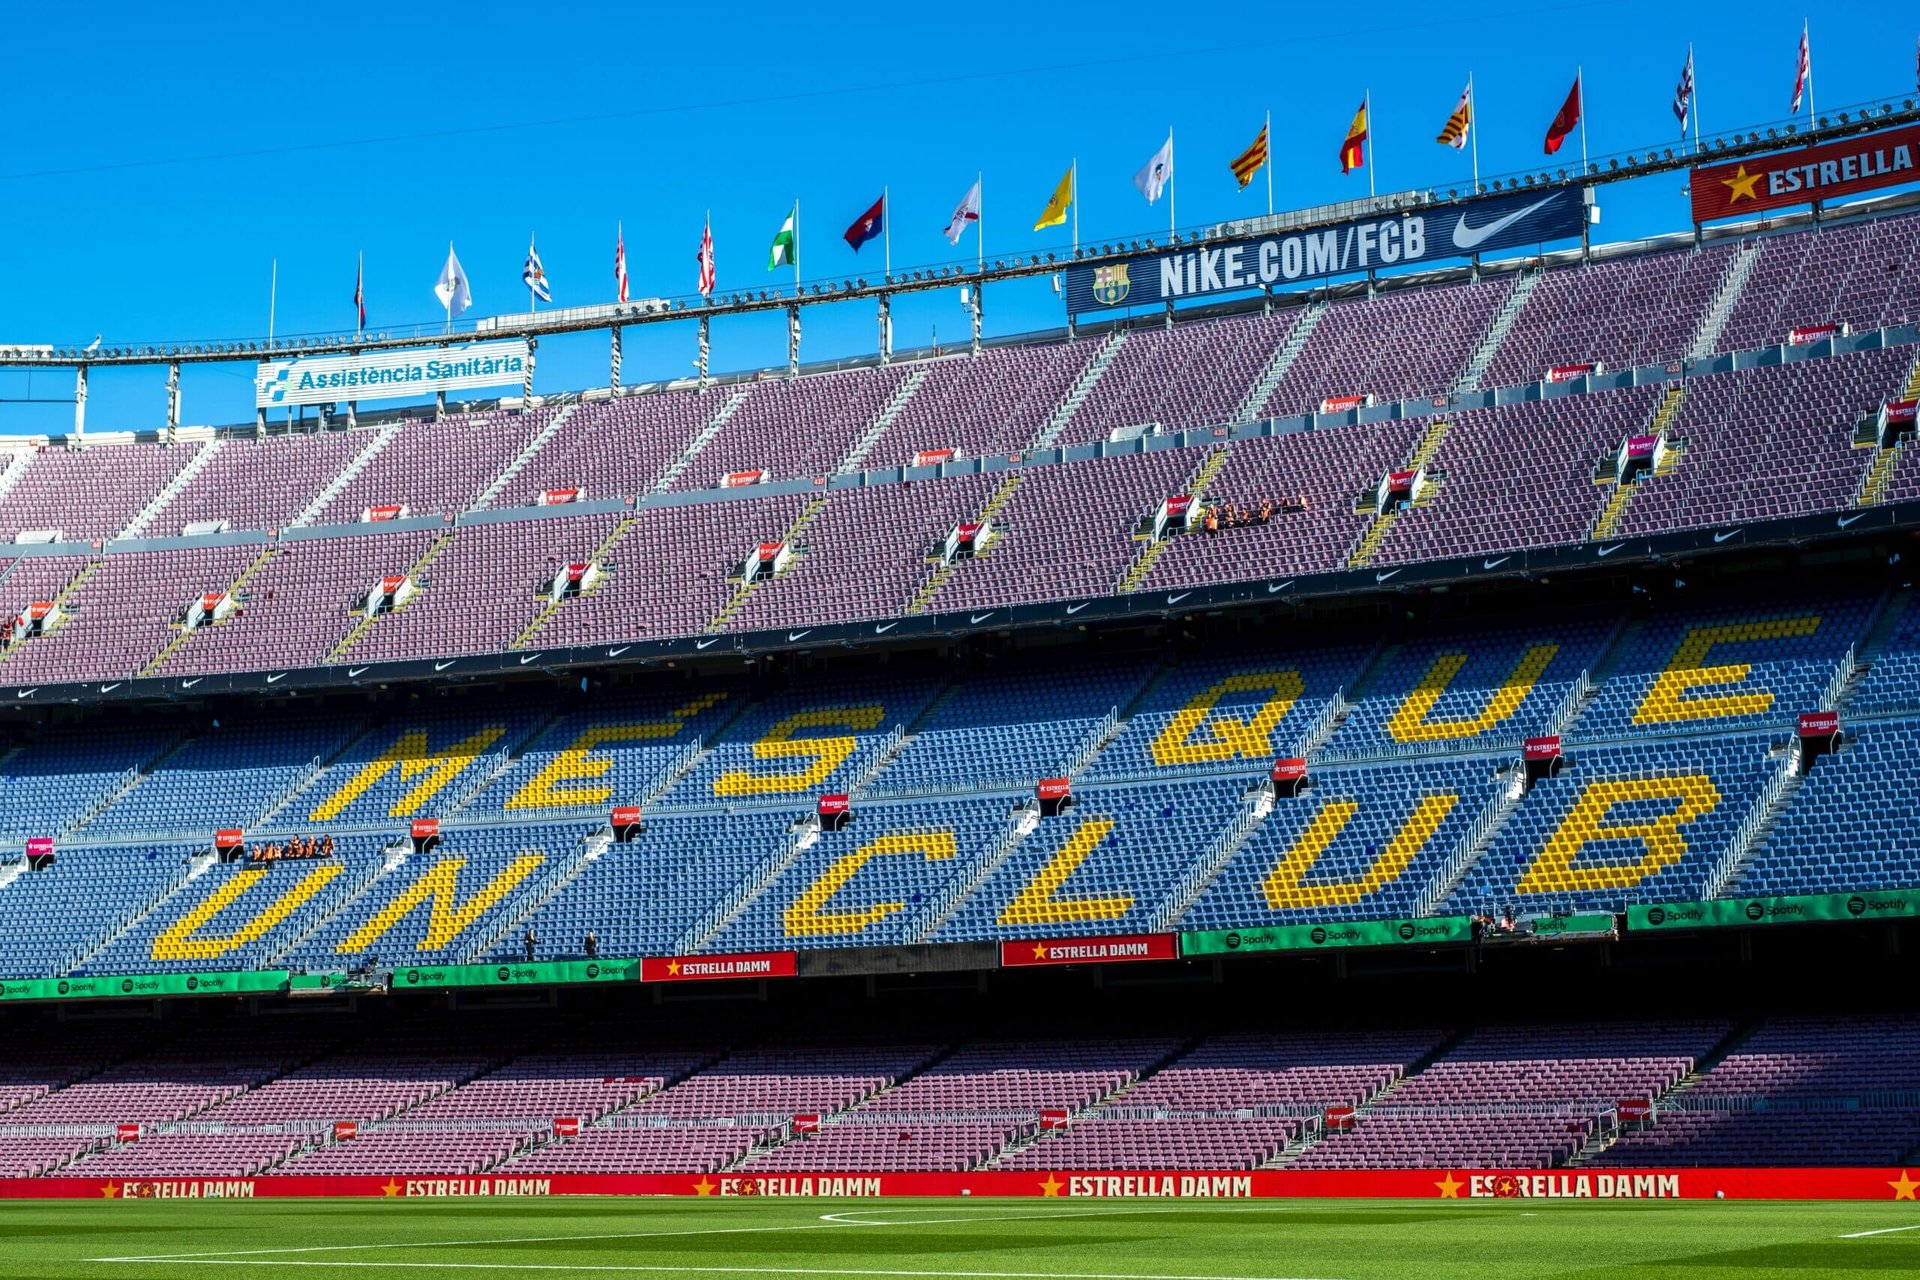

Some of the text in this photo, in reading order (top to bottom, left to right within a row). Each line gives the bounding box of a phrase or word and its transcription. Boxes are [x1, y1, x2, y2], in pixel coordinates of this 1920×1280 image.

[1767, 144, 1912, 196] ESTRELLA
[1160, 216, 1425, 298] NIKE.COM/FCB
[299, 354, 522, 391] Assistència Sanitària
[1666, 364, 1680, 373] 433
[1433, 398, 1446, 407] 434
[1214, 428, 1225, 436] 435
[1152, 616, 1822, 767] QUE
[1809, 719, 1838, 728] ESTRELLA
[1533, 743, 1560, 751] ESTRELLA
[152, 774, 1722, 960] UN CLUB
[1766, 903, 1804, 917] Spotify
[1868, 898, 1908, 912] Spotify
[1667, 909, 1704, 922] Spotify
[1328, 928, 1361, 942] Spotify
[1417, 924, 1451, 937] Spotify
[1242, 932, 1275, 946] Spotify
[1050, 942, 1148, 960] ESTRELLA DAMM
[683, 960, 771, 976] ESTRELLA DAMM
[199, 975, 225, 989] Spotify
[420, 970, 447, 983] Spotify
[511, 969, 537, 983] Spotify
[6, 984, 31, 997] Spotify
[71, 981, 95, 994] Spotify
[134, 979, 160, 993] Spotify
[203, 1181, 255, 1198] DAMM
[406, 1179, 551, 1197] ESTRELLA DAMM
[818, 1177, 882, 1197] DAMM
[1069, 1176, 1252, 1198] ESTRELLA DAMM
[1597, 1174, 1681, 1198] DAMM
